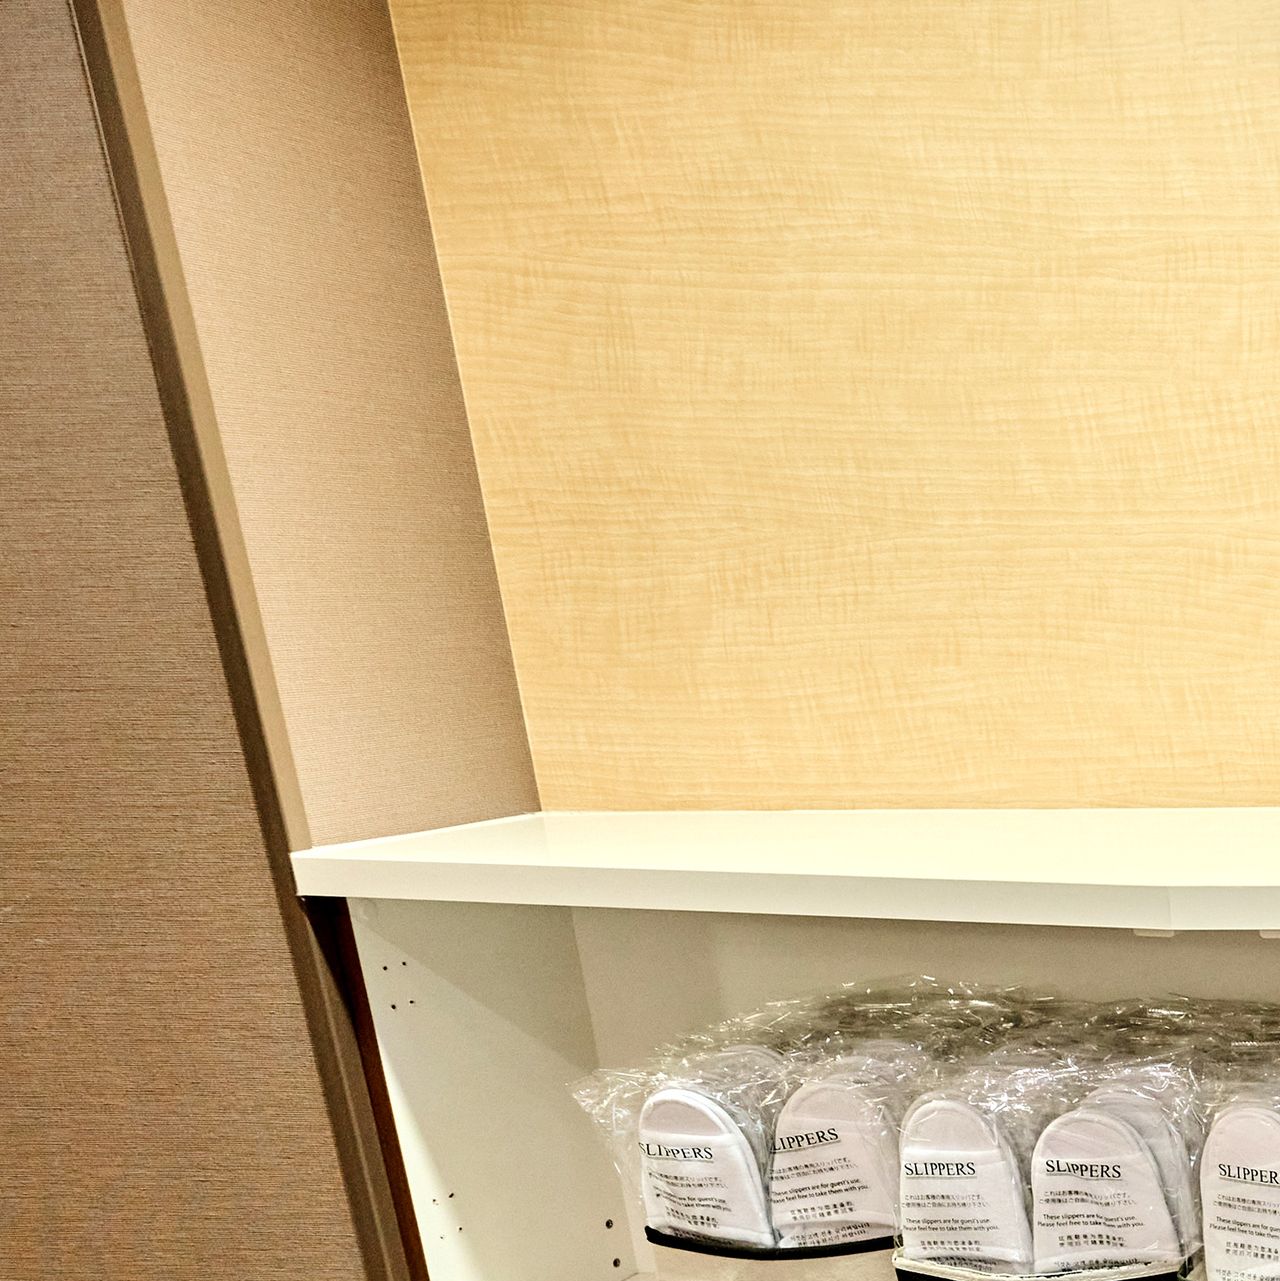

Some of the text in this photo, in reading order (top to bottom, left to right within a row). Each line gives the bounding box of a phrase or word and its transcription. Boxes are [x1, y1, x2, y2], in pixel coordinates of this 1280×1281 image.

[638, 1142, 713, 1160] SLIPPERS
[904, 1162, 976, 1176] SLIPPERS
[1045, 1159, 1121, 1179] SLIPPERS
[1217, 1216, 1230, 1224] These
